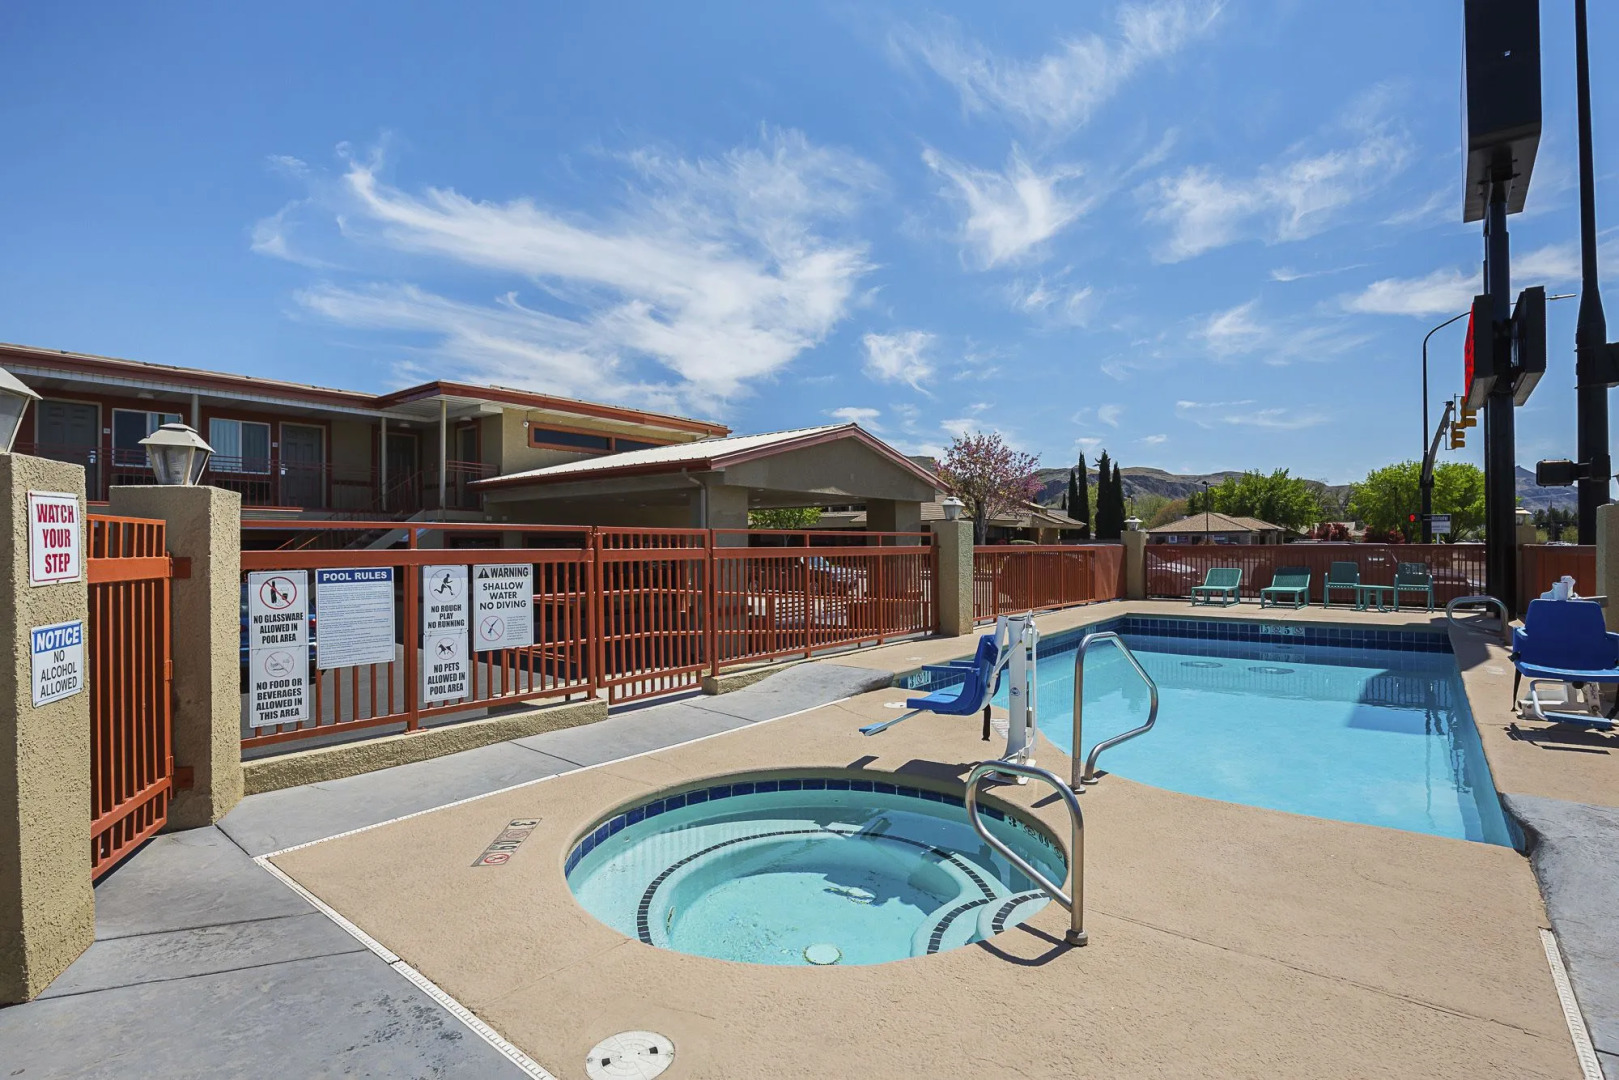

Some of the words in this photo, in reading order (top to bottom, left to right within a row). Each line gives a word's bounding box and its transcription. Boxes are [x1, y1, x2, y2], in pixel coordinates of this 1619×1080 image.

[36, 503, 75, 524] WATCH
[42, 528, 71, 549] YOUR
[45, 553, 71, 574] STEP
[323, 572, 352, 582] POOL
[354, 571, 388, 580] RULES
[490, 567, 529, 578] WARNING
[482, 582, 524, 591] SHALLOW
[489, 591, 517, 600] WATER
[431, 605, 440, 613] NO
[440, 604, 462, 612] ROUGH
[479, 602, 494, 610] NO
[496, 600, 527, 609] DIVING
[253, 615, 263, 624] NO
[264, 612, 304, 623] GLASSWARE
[439, 612, 454, 620] PLAY
[259, 623, 290, 634] ALLOWED
[290, 622, 298, 632] IN
[427, 621, 437, 629] NO
[437, 619, 465, 628] RUNNING
[35, 626, 80, 650] NOTICE
[261, 635, 279, 644] POOL
[280, 633, 297, 642] AREA
[53, 649, 65, 664] NO
[433, 664, 443, 674] NO
[444, 662, 460, 672] PETS
[40, 667, 78, 683] ALCOHOL
[427, 673, 457, 685] ALLOWED
[458, 671, 466, 681] IN
[40, 676, 78, 698] ALLOWED
[256, 681, 268, 691] NO
[269, 679, 290, 689] FOOD
[291, 678, 303, 687] OR
[429, 684, 447, 695] POOL
[447, 683, 464, 694] AREA
[257, 688, 302, 701] BEVERAGES
[256, 699, 293, 711] ALLOWED
[294, 697, 303, 707] IN
[259, 711, 278, 721] THIS
[279, 708, 300, 718] AREA
